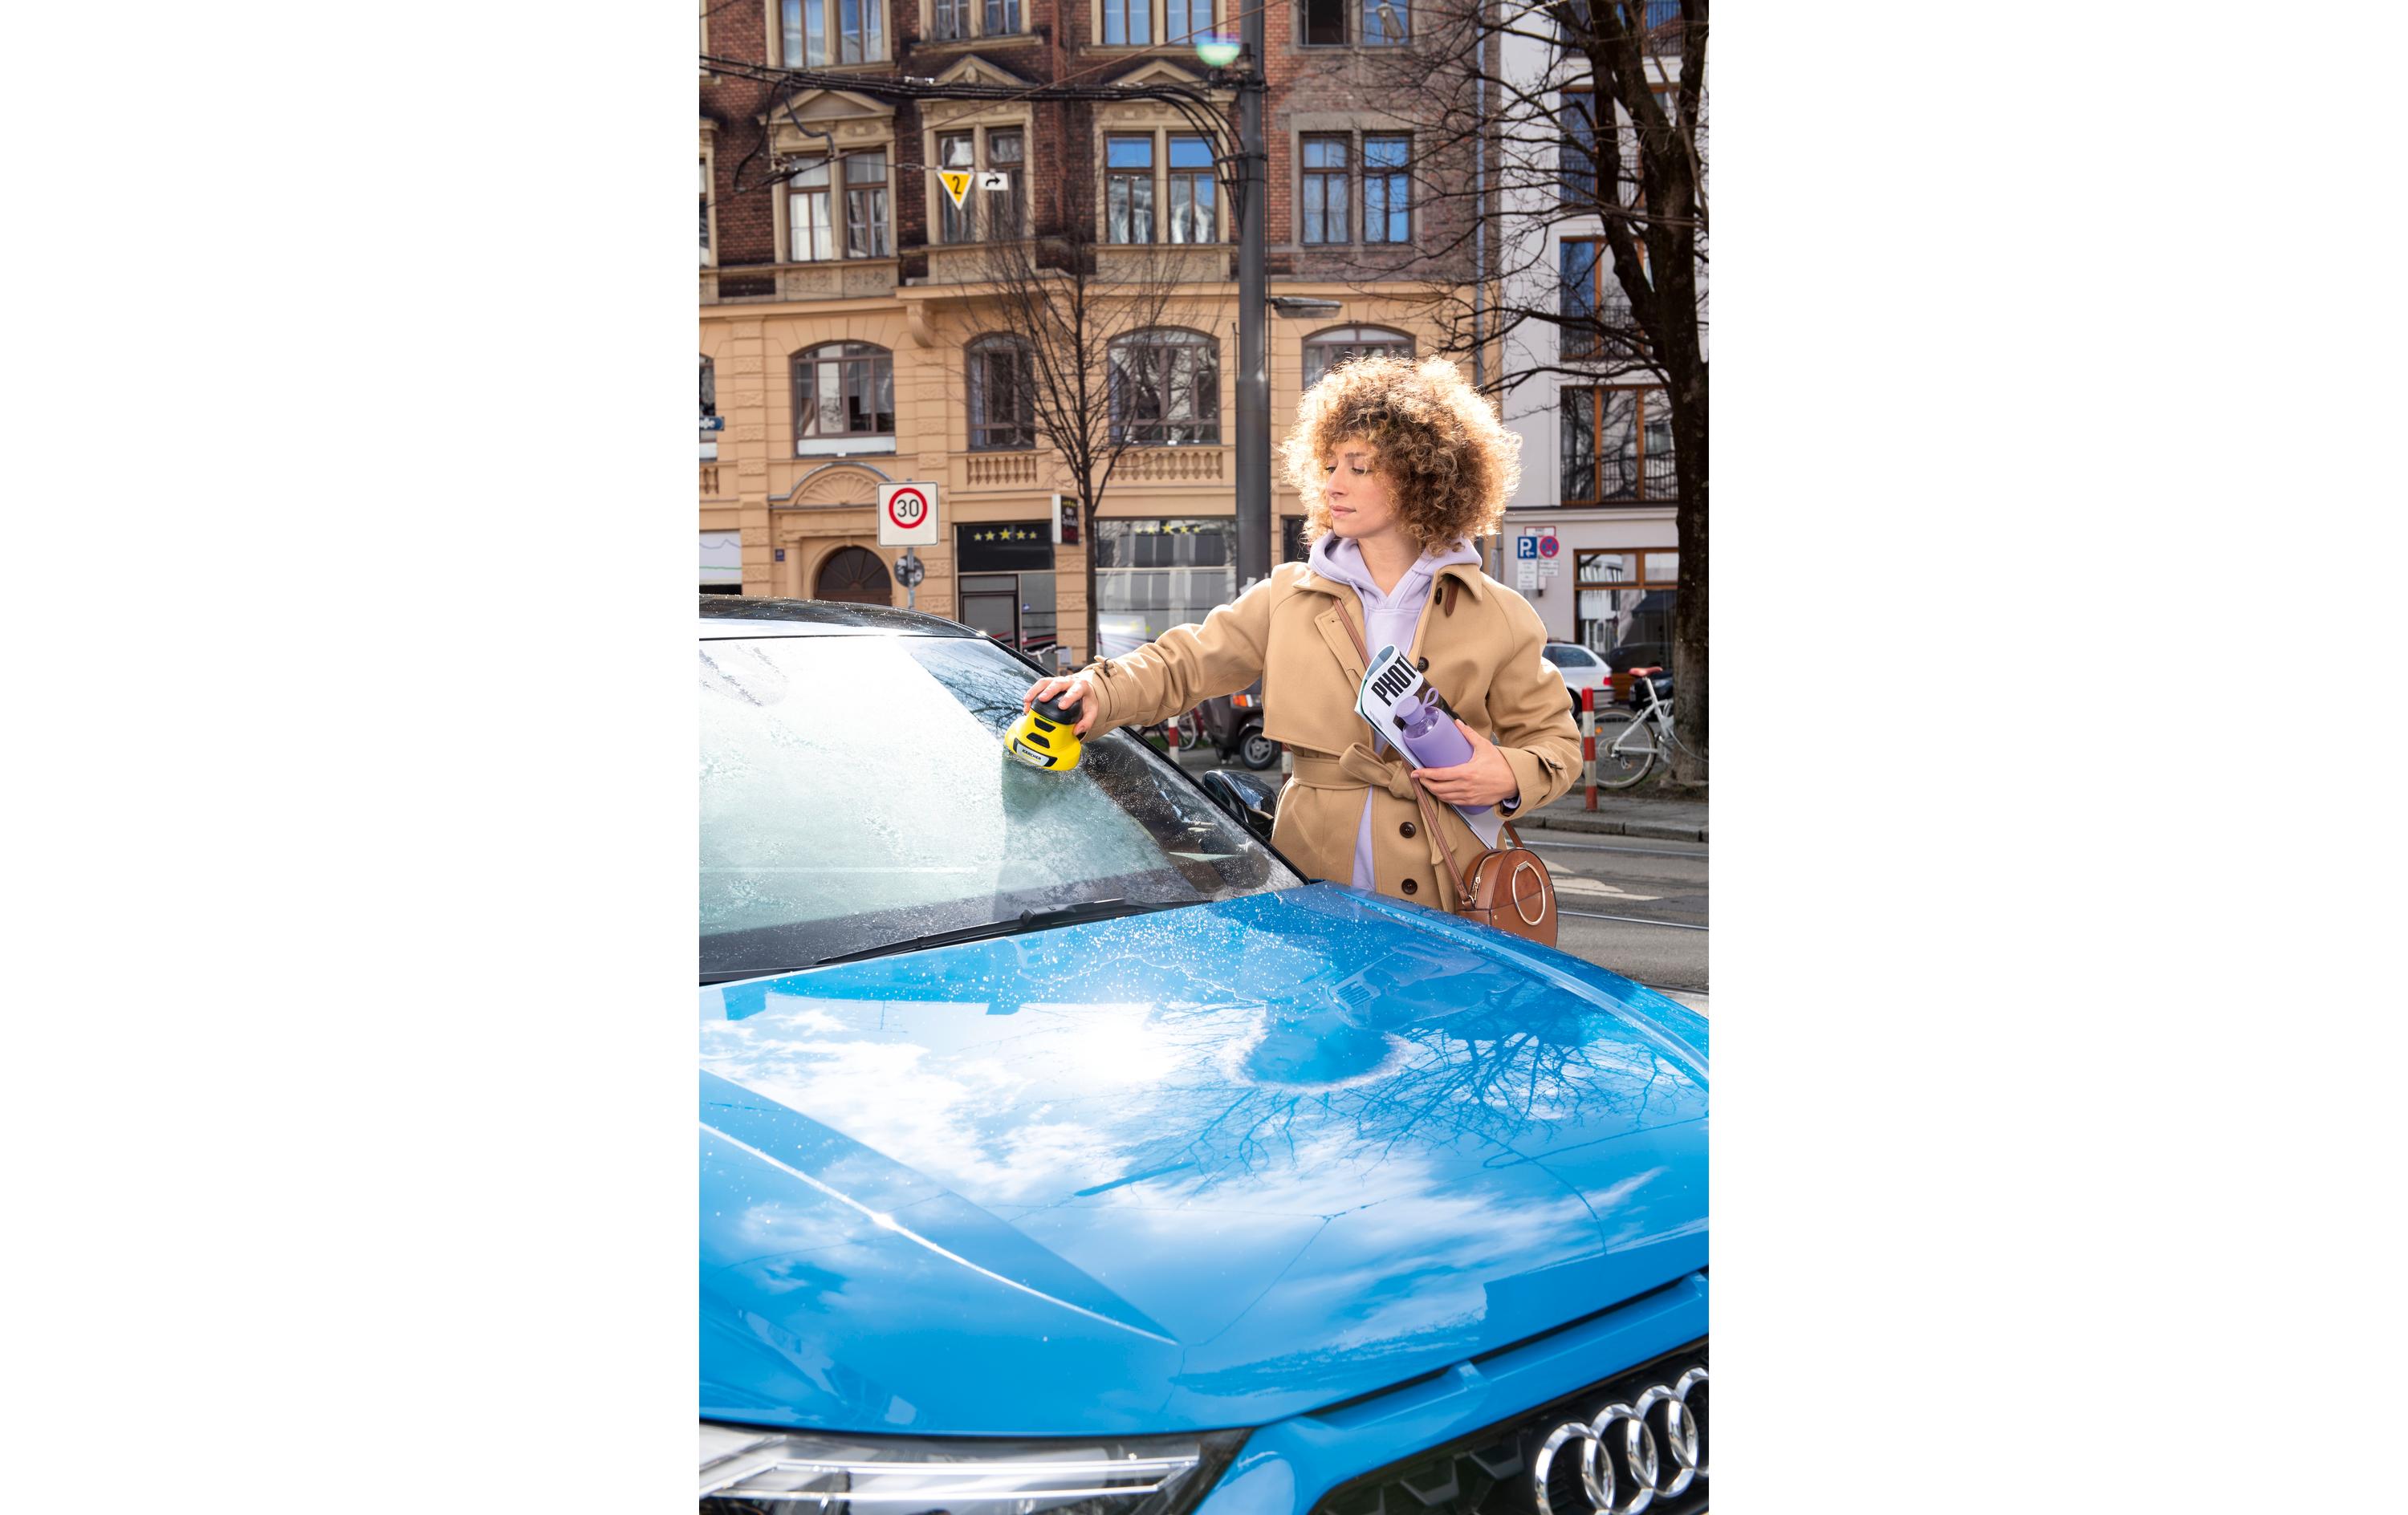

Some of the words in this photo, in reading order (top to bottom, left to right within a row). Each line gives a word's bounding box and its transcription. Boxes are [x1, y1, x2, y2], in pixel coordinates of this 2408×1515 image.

[952, 175, 962, 194] 2
[897, 499, 919, 518] 30
[1519, 538, 1532, 557] P
